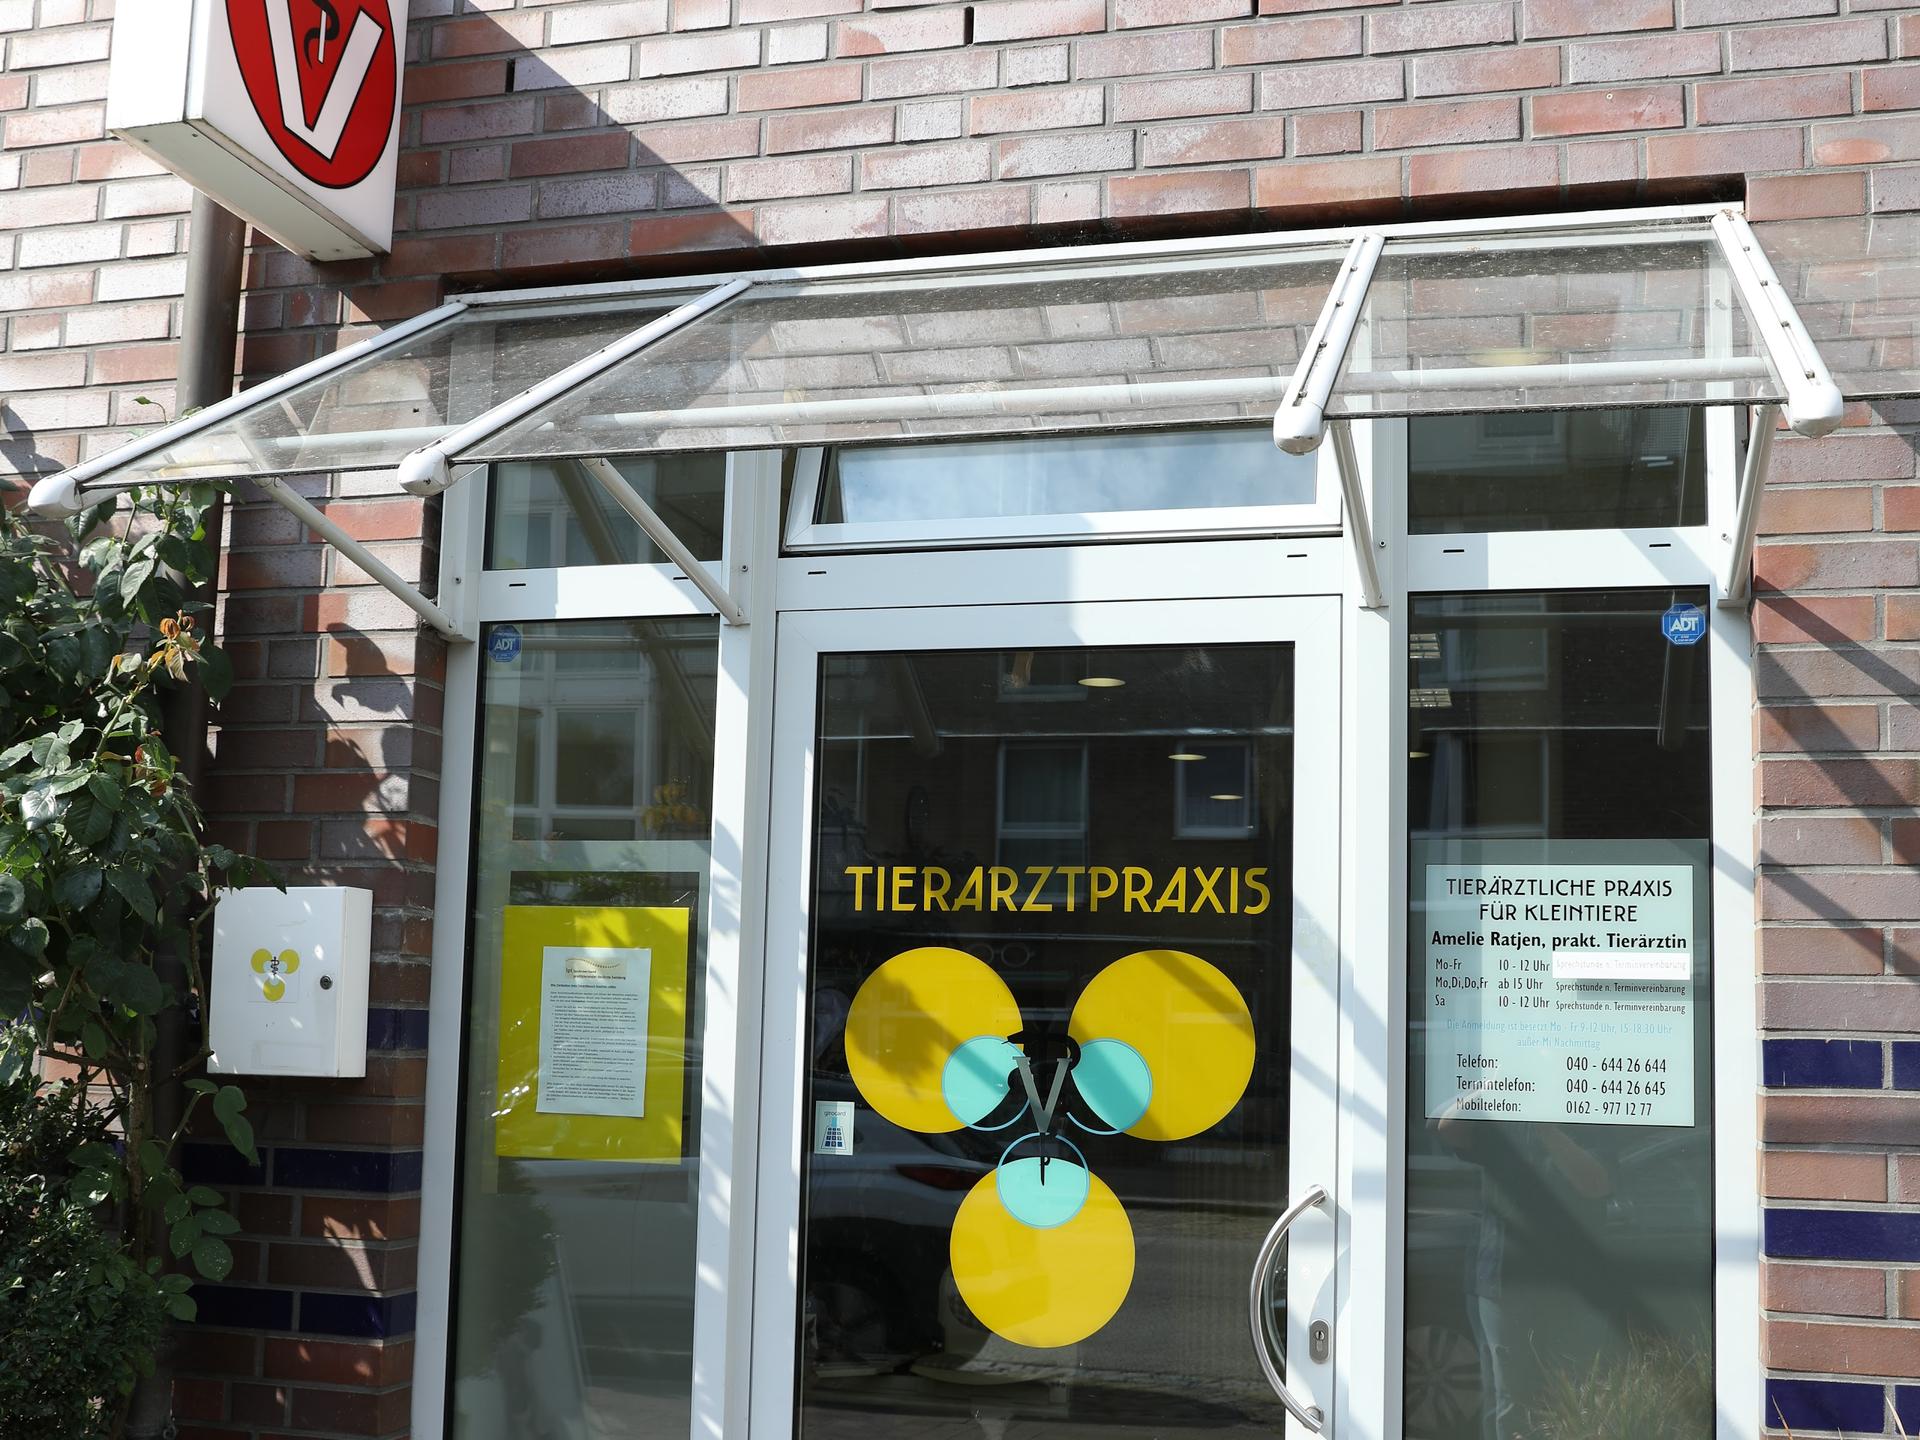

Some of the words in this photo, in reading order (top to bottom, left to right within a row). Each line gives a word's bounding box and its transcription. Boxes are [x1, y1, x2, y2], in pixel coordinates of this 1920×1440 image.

[1670, 617, 1698, 631] ADT
[494, 639, 516, 651] ADT
[844, 866, 1271, 915] TIERARZTPRAXIS
[1446, 875, 1596, 897] TIERÄRZTLICHE
[1604, 880, 1672, 897] PRAXIS
[1480, 900, 1517, 920] FÜR
[1526, 904, 1637, 922] KLEINTIERE
[1432, 931, 1484, 946] Amelie
[1491, 931, 1546, 950] Ratjen,
[1552, 933, 1600, 951] prakt.
[1606, 933, 1687, 949] Tierärztin
[1435, 958, 1462, 970] Mo-Fr
[1499, 959, 1509, 971] 10
[1520, 959, 1529, 971] 12
[1533, 960, 1550, 971] Uhr
[1498, 978, 1509, 989] ab
[1514, 978, 1523, 989] 15
[1526, 978, 1544, 990] Uhr
[1556, 982, 1603, 993] Sprechstunde
[1614, 983, 1686, 995] Terminvereinbarung
[1435, 994, 1446, 1006] Sa
[1499, 996, 1509, 1007] 10
[1520, 996, 1529, 1007] 12
[1533, 996, 1550, 1008] Uhr
[1556, 1001, 1603, 1011] Sprechstunde
[1614, 1002, 1686, 1014] Terminvereinbarung
[1657, 1024, 1672, 1034] Uhr
[1554, 1038, 1601, 1051] Nachmittag
[1456, 1053, 1498, 1068] Telefon:
[1567, 1056, 1588, 1071] 040
[1601, 1057, 1622, 1072] 644
[1627, 1058, 1640, 1072] 26
[1645, 1058, 1666, 1073] 644
[1456, 1075, 1535, 1092] Termintelefon:
[1567, 1078, 1588, 1093] 040
[1601, 1080, 1622, 1094] 644
[1627, 1080, 1640, 1095] 26
[1645, 1081, 1666, 1096] 645
[1456, 1098, 1521, 1112] Mobiltelefon:
[1566, 1100, 1590, 1114] 0162
[1602, 1101, 1621, 1115] 977
[1626, 1102, 1636, 1115] 12
[1640, 1102, 1652, 1116] 77
